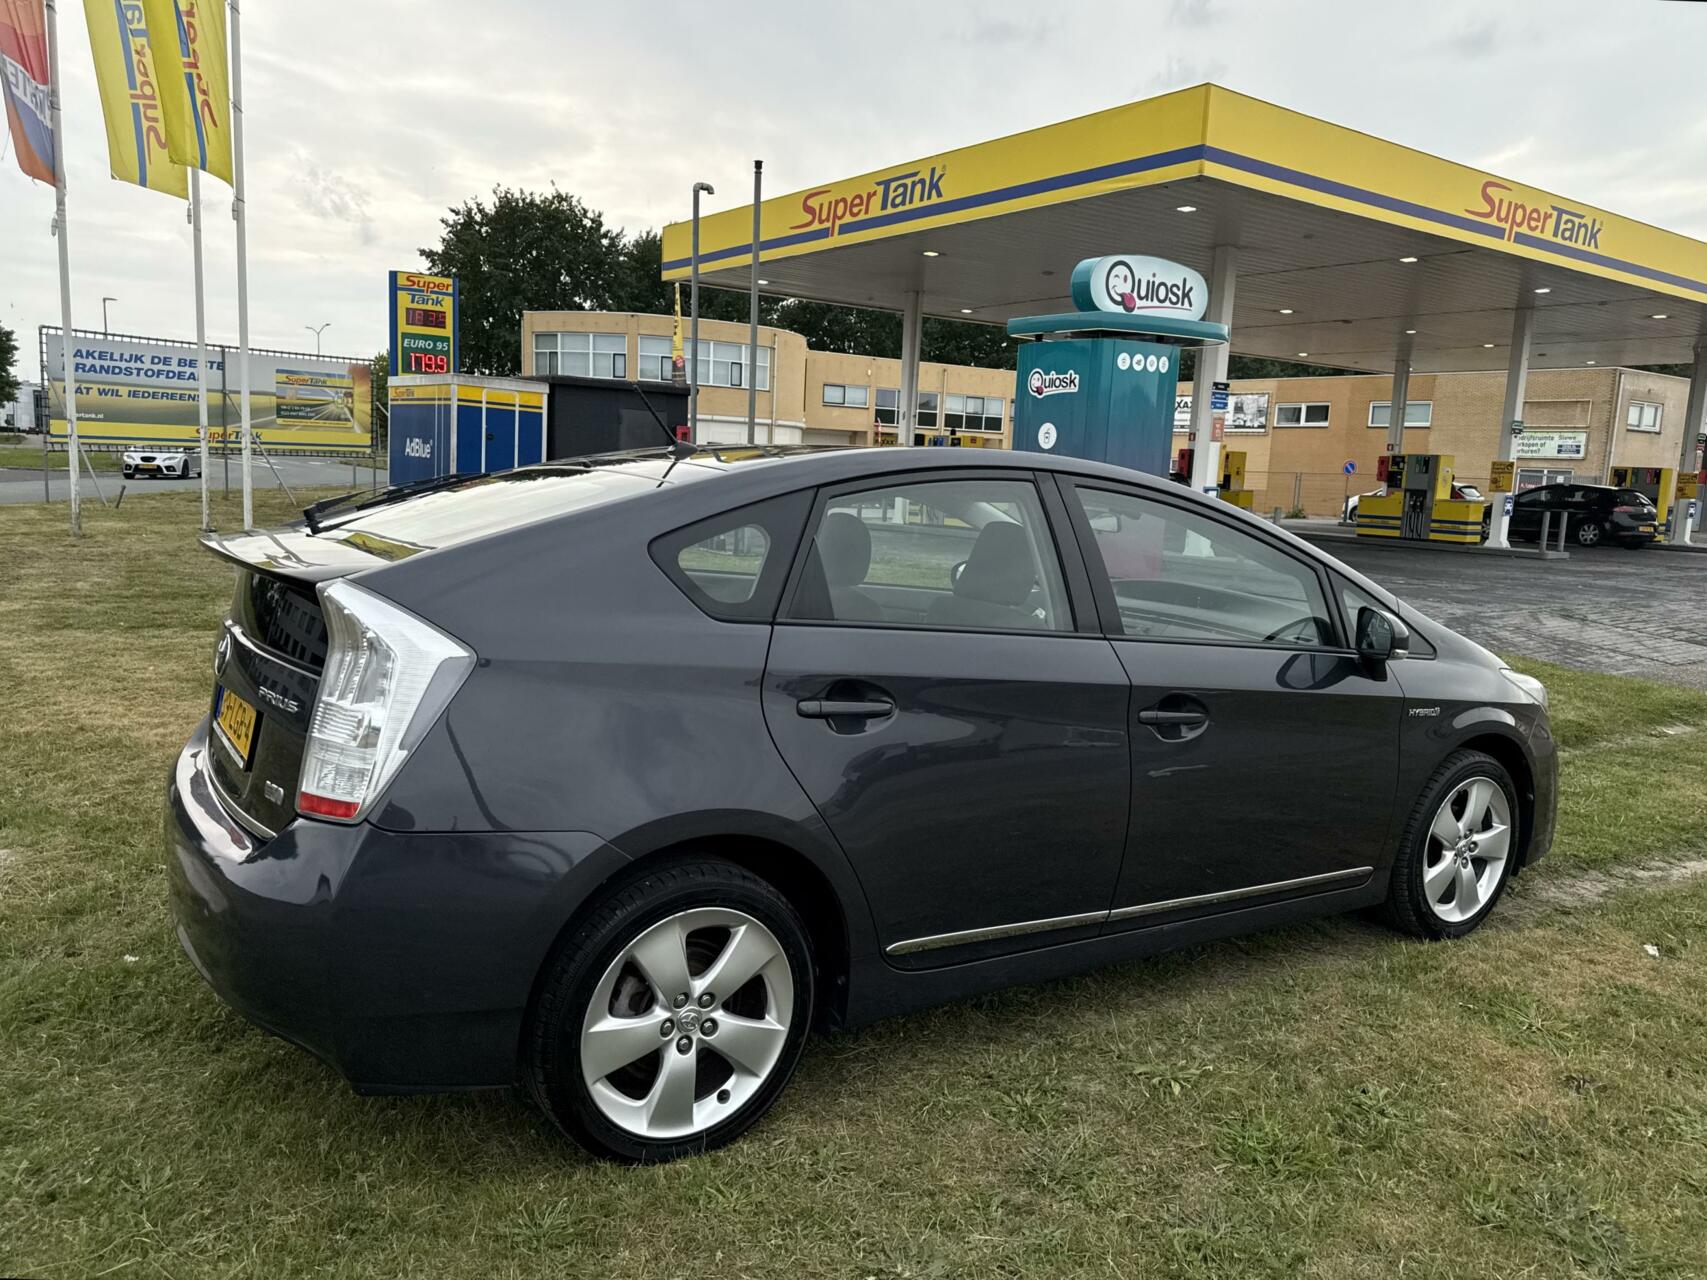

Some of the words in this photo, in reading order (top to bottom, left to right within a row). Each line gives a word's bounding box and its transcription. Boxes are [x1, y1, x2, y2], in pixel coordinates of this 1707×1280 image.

[399, 275, 452, 294] Super
[1105, 260, 1193, 313] Quiosk
[407, 293, 445, 307] Tank
[403, 338, 433, 349] EURO
[436, 342, 449, 351] 95
[61, 348, 145, 365] AKELIJK
[150, 355, 173, 367] DE
[177, 358, 225, 371] BETE
[62, 362, 200, 382] RANDSTOFDEA
[1030, 371, 1077, 395] Quiosk
[63, 384, 93, 396] ÁT
[97, 388, 123, 398] WIL
[127, 390, 200, 402] IEDEREEN!
[259, 686, 299, 713] PRIUS
[1408, 708, 1437, 717] HYBRID
